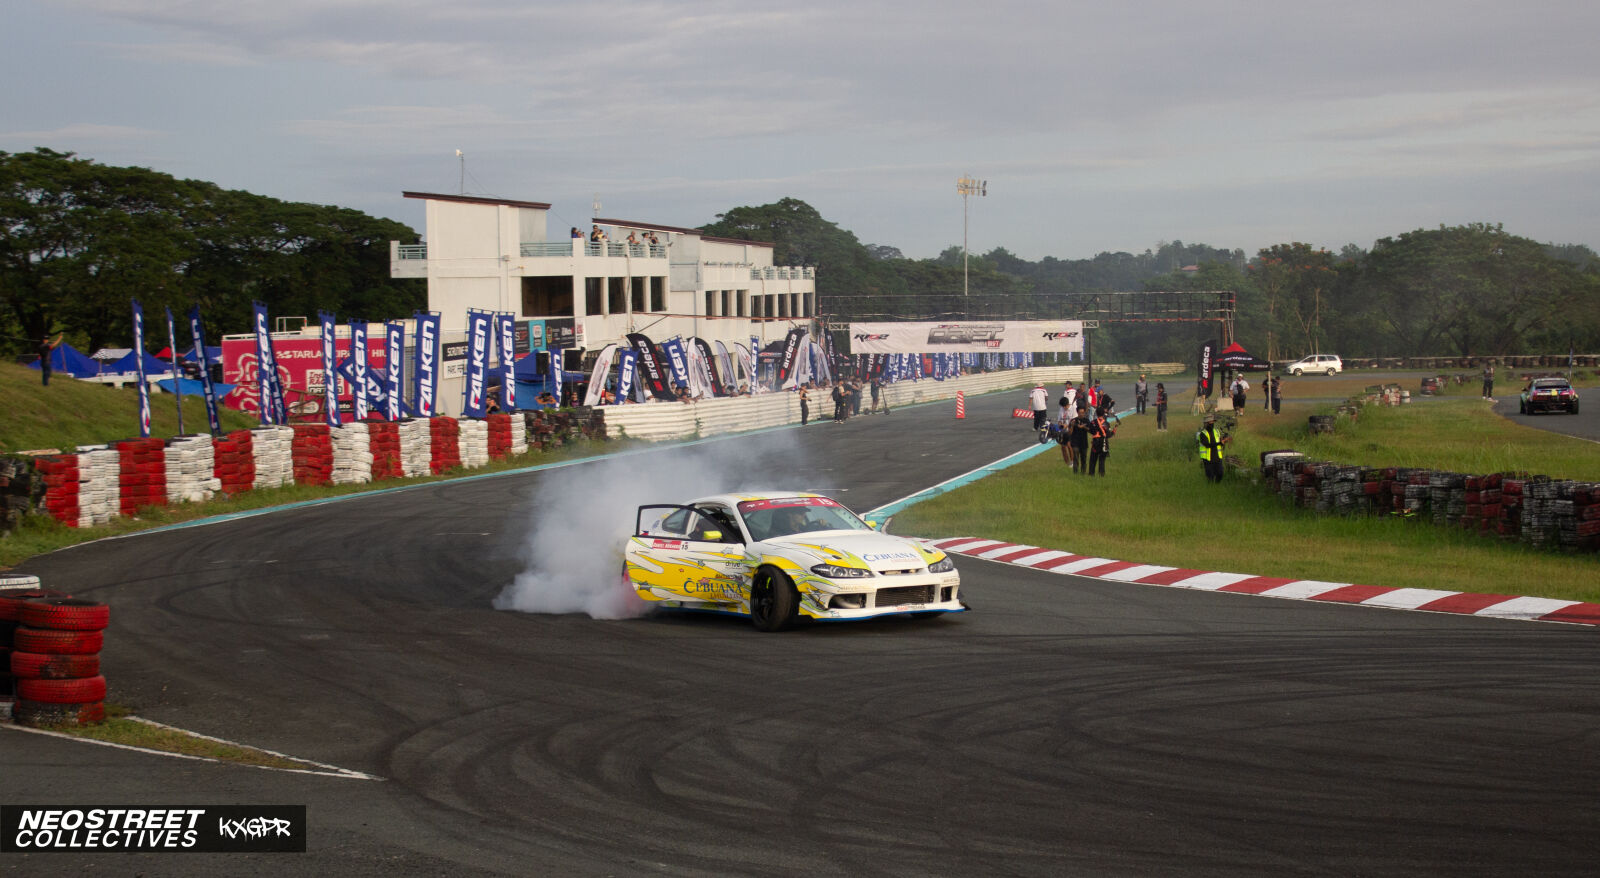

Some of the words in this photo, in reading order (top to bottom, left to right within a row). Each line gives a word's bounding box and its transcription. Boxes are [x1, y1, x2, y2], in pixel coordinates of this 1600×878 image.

[294, 350, 322, 358] TARLA
[419, 320, 435, 417] FALKEN
[469, 318, 487, 410] FALKEN
[502, 320, 515, 407] FALKEN
[638, 340, 659, 379] ardeca
[668, 344, 688, 381] KEN
[782, 333, 797, 369] ardeca
[1202, 346, 1210, 379] ardeca
[324, 321, 338, 424] FALKEN
[620, 355, 634, 396] KEN
[684, 578, 743, 593] CEBUANA
